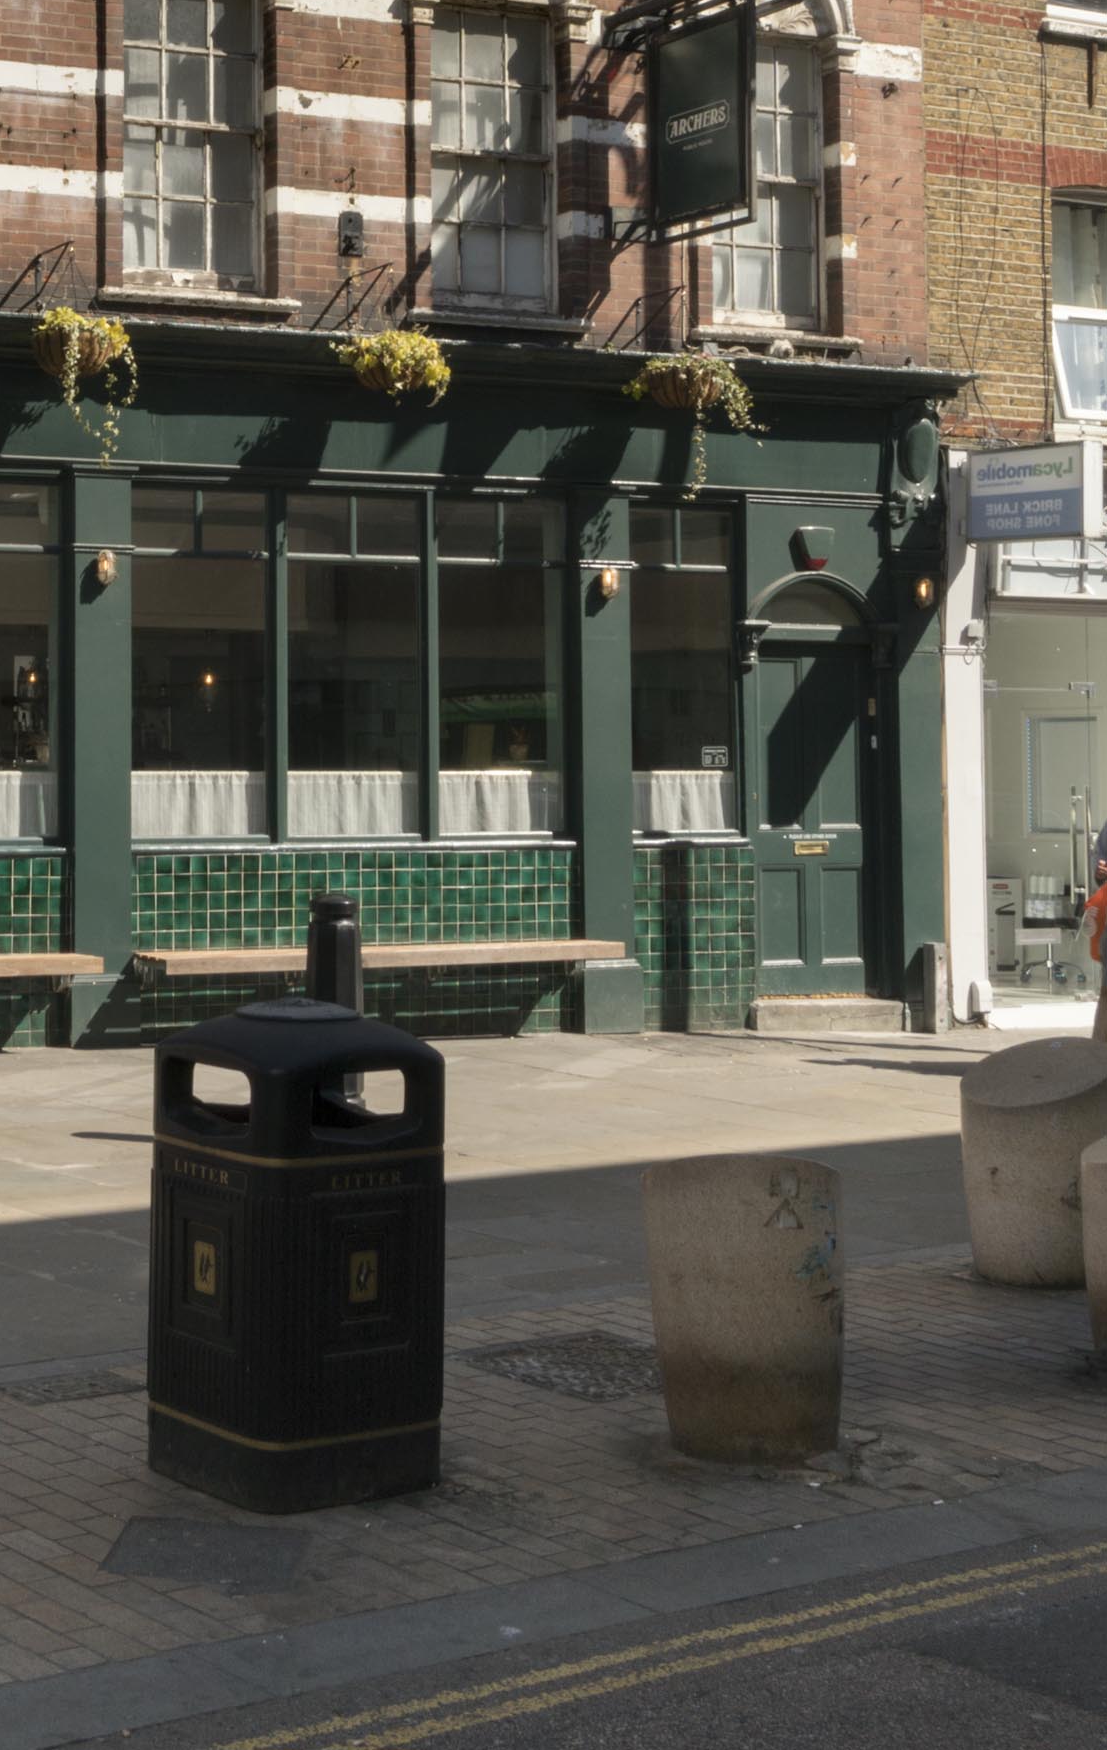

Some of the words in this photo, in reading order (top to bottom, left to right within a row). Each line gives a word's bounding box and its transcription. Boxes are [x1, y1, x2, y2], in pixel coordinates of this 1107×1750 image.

[670, 106, 726, 139] ARCHERS
[174, 1158, 230, 1185] LITTER
[331, 1170, 402, 1190] LITTER
